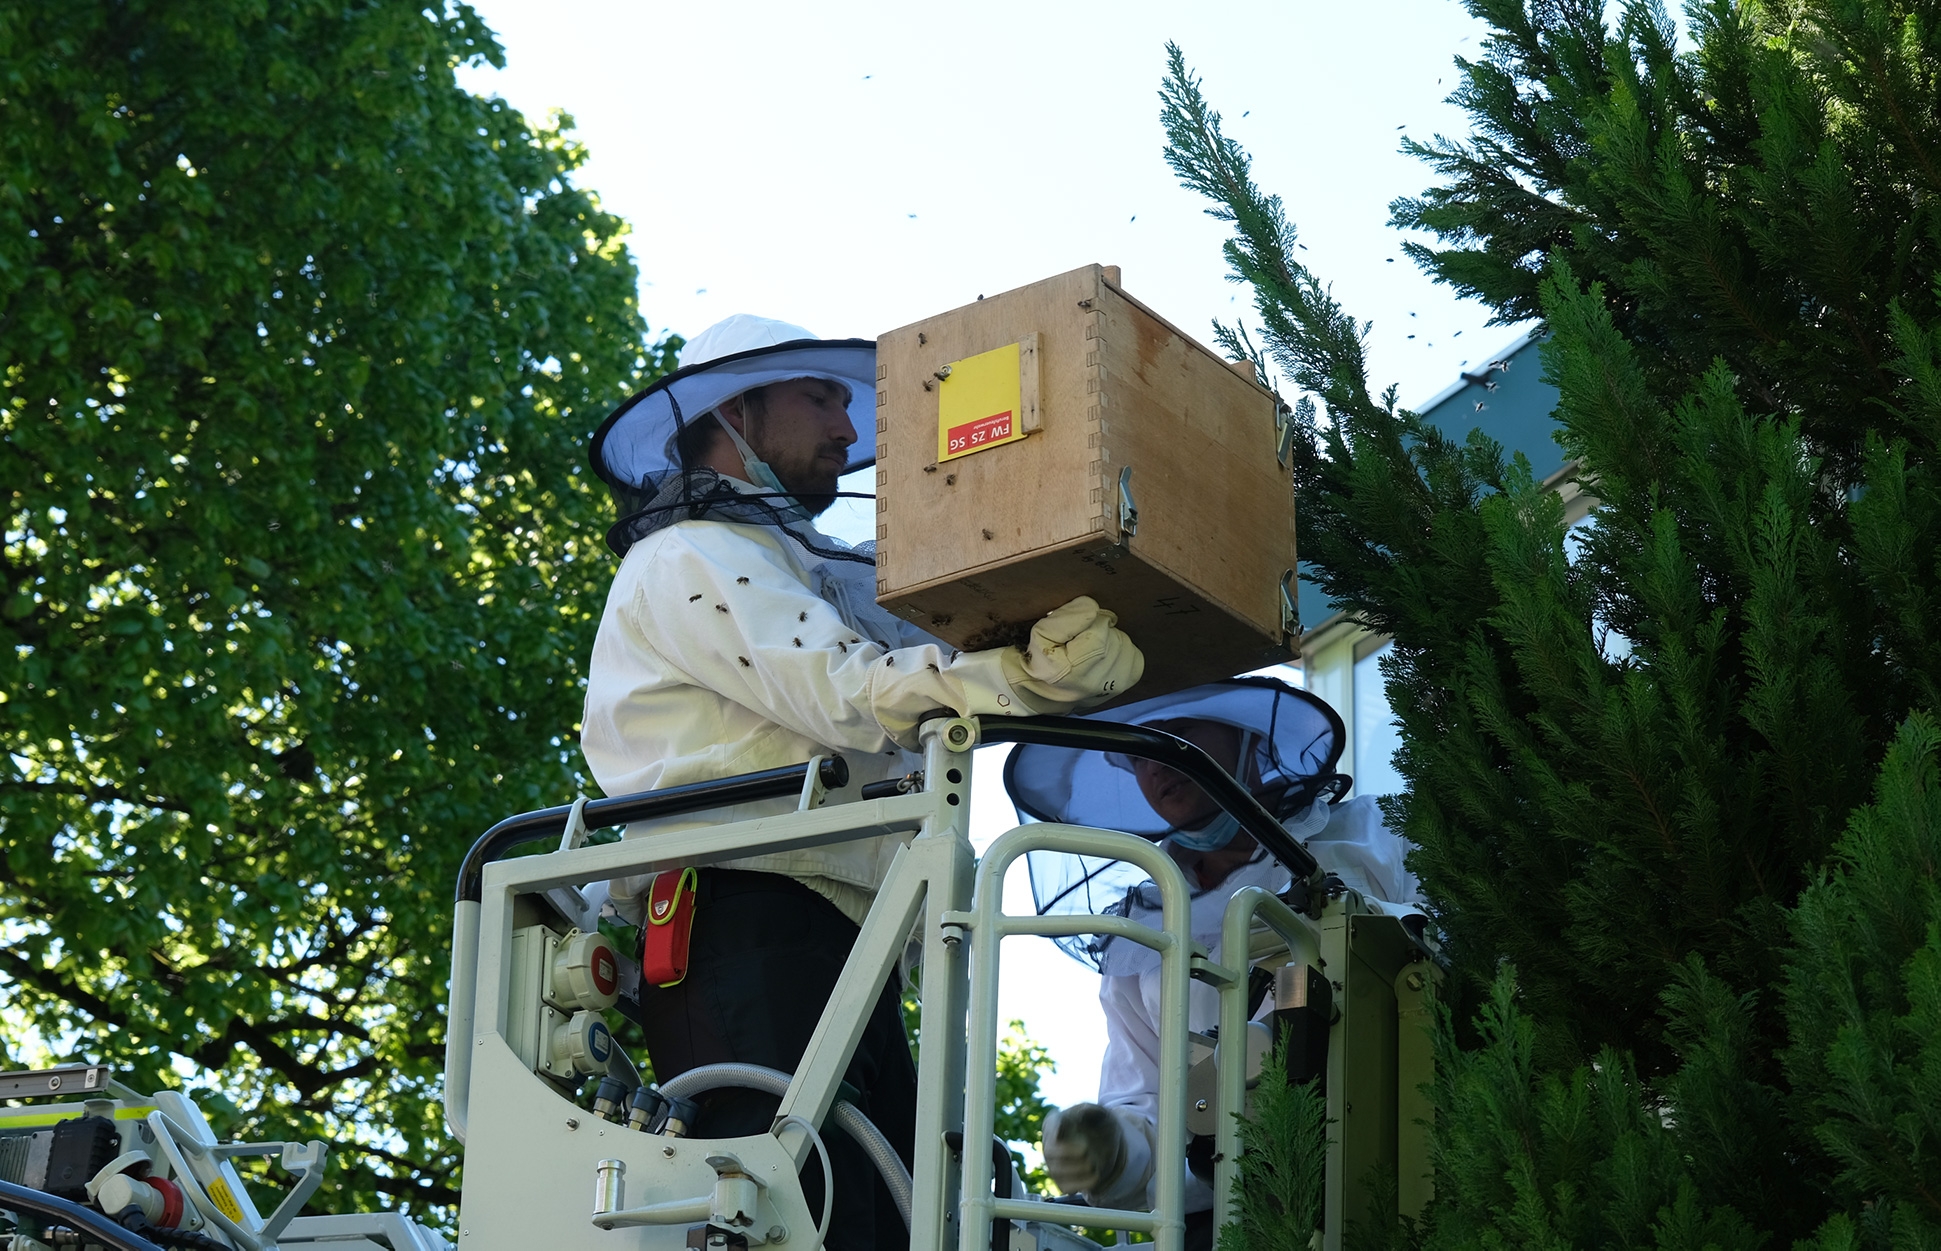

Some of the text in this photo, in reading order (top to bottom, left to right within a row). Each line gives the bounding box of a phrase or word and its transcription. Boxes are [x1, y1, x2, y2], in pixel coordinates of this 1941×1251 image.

[950, 424, 1009, 450] FW ZS SG
[1152, 596, 1200, 615] 47
[1103, 680, 1115, 691] CE
